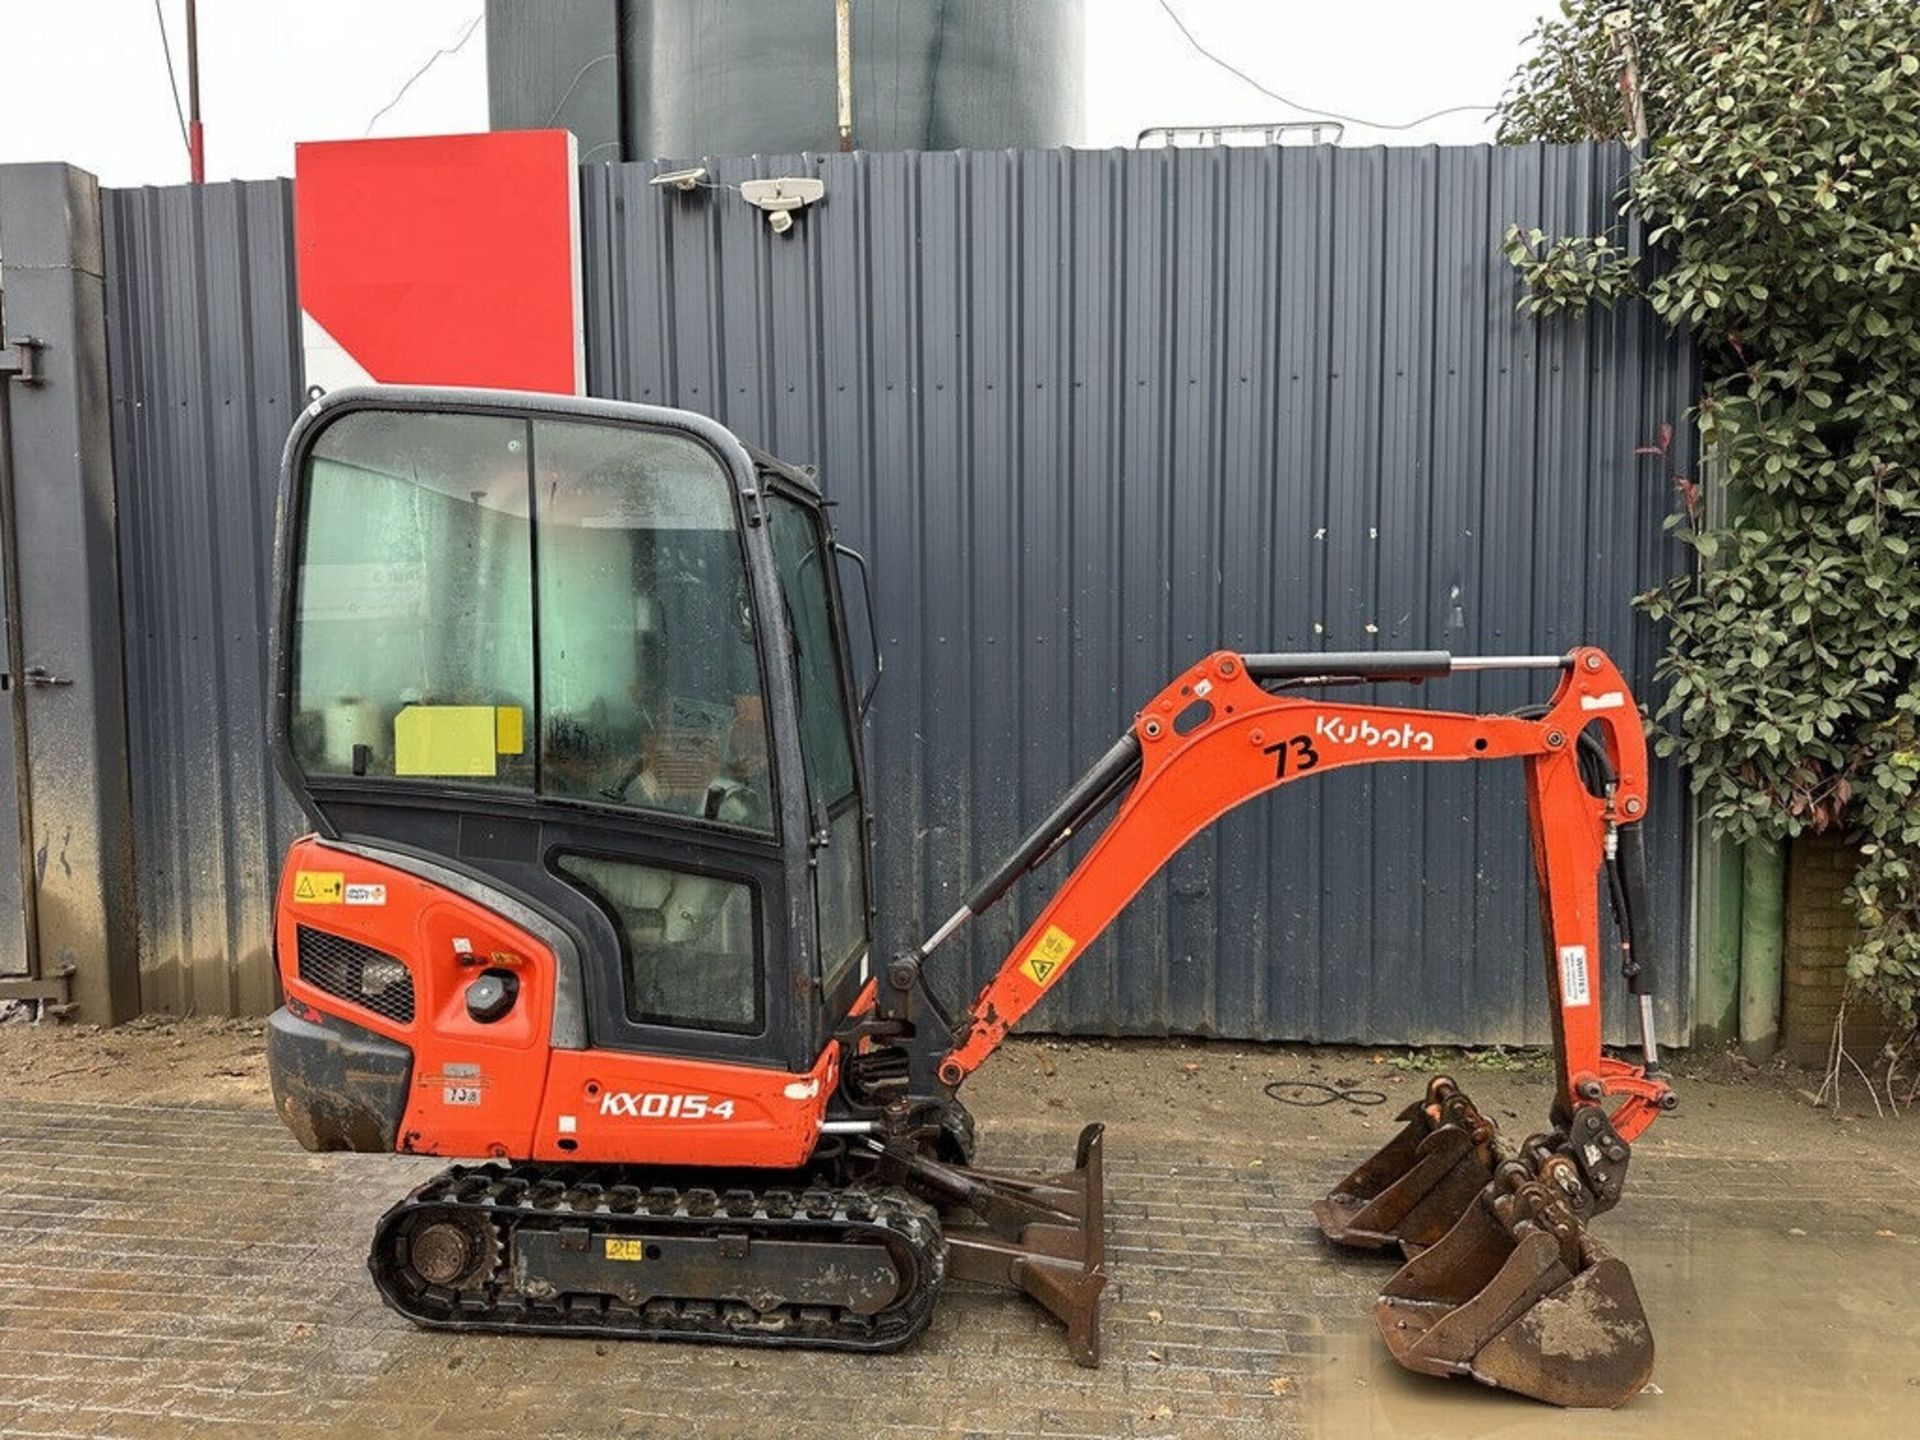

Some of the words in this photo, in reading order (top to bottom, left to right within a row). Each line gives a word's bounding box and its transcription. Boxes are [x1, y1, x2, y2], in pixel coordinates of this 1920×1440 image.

[1315, 716, 1434, 751] Kubota
[1263, 735, 1319, 779] 73
[599, 1091, 735, 1121] KX015-4
